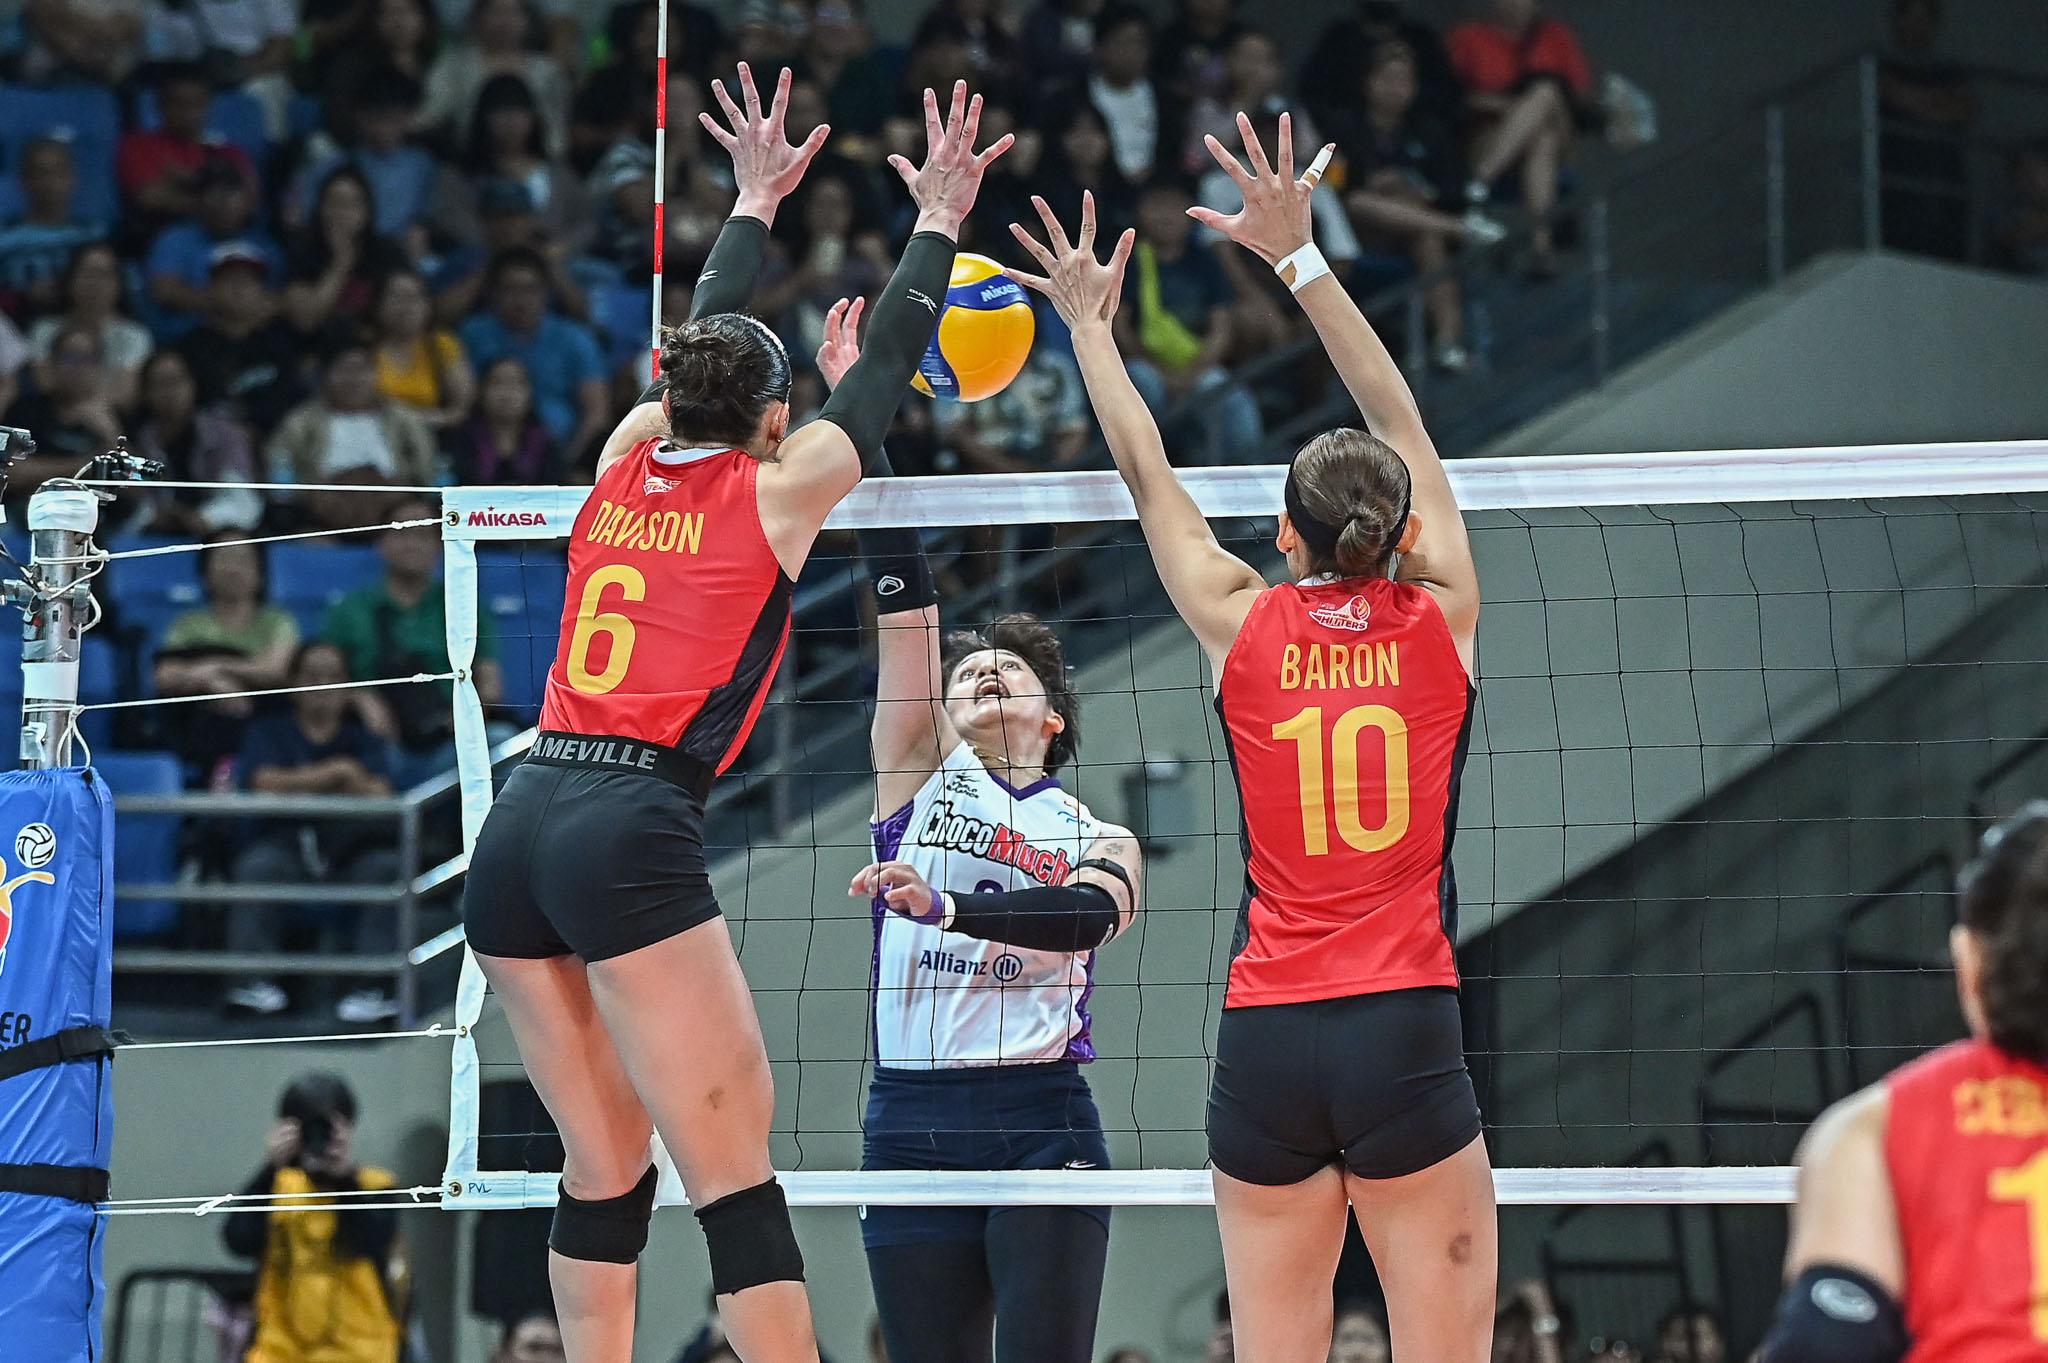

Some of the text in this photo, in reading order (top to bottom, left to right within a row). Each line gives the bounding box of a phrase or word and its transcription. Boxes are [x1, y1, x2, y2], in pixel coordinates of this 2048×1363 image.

[468, 506, 547, 527] MIKASA
[586, 500, 705, 555] DAVISON
[567, 564, 646, 695] 6
[1280, 640, 1400, 690] BARON
[1271, 704, 1410, 856] 10
[919, 950, 987, 976] Allianz
[468, 1182, 492, 1193] PVL
